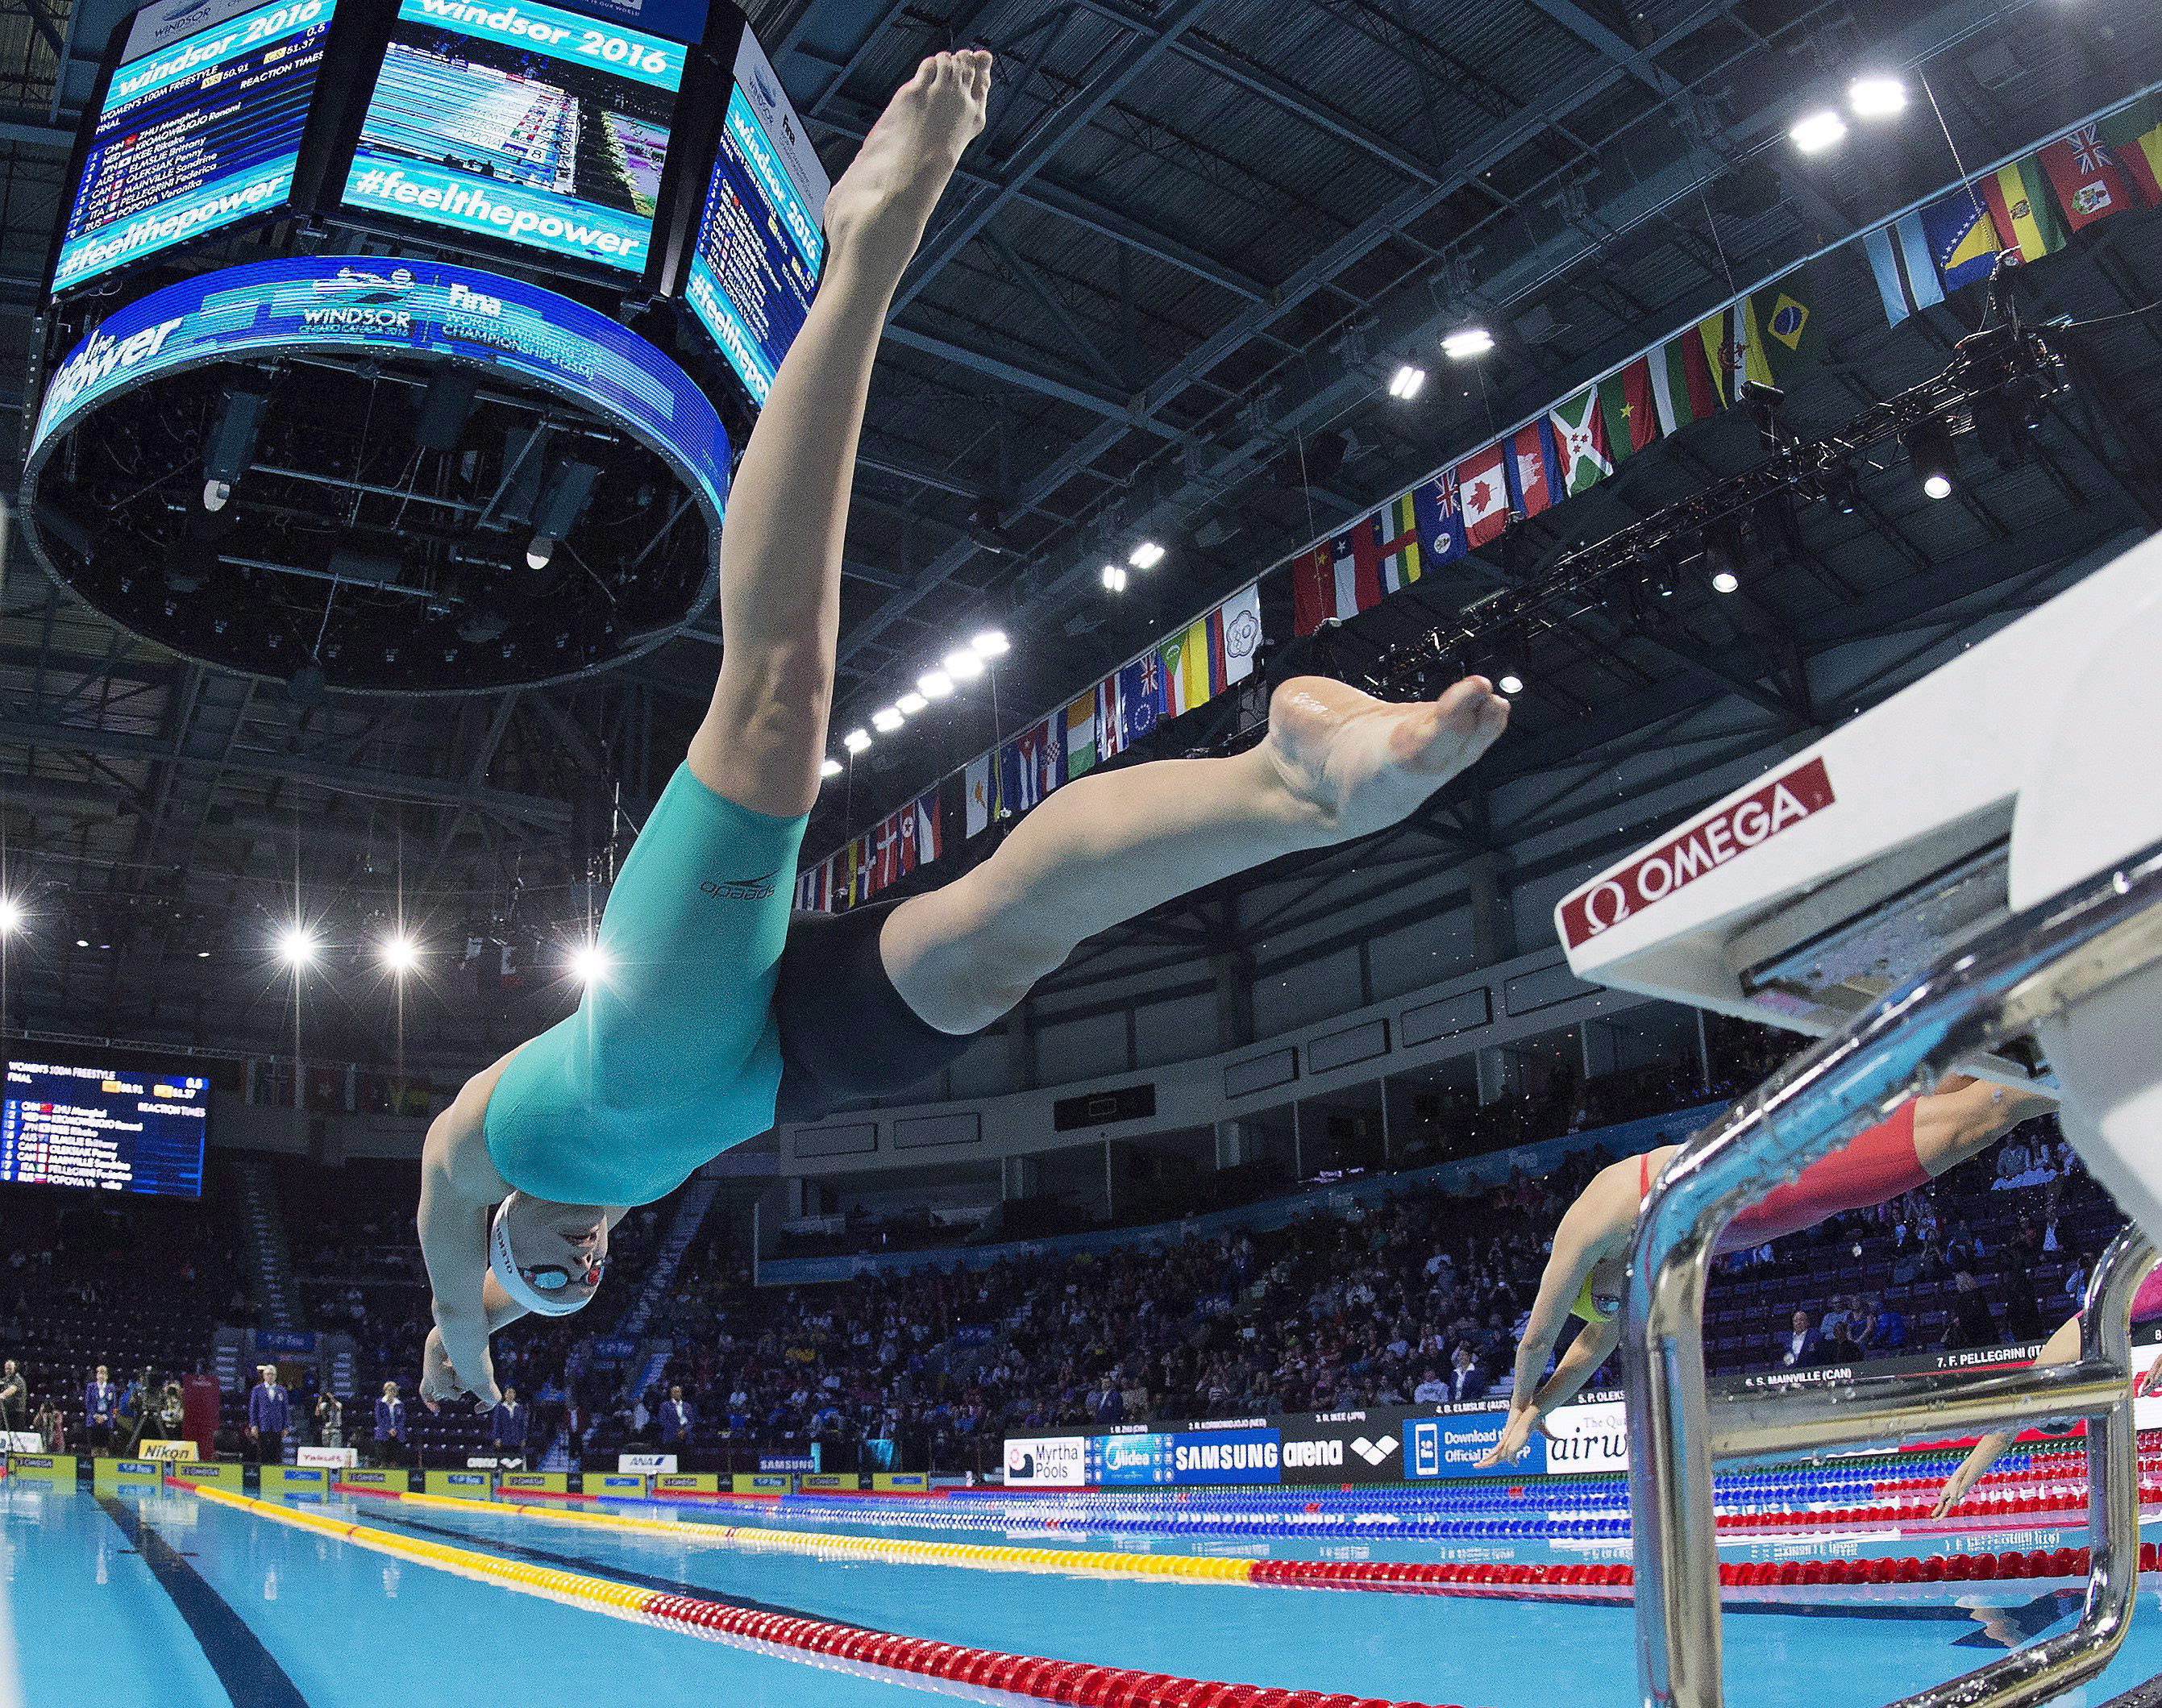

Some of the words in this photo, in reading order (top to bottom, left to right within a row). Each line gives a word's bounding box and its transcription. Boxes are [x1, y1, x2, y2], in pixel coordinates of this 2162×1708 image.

[155, 7, 211, 38] WINDSOR
[422, 0, 572, 45] windsor
[576, 31, 668, 74] 2016
[119, 34, 239, 97] windsor
[243, 1, 322, 45] 2016
[170, 65, 218, 93] FREESTYLE
[240, 64, 293, 89] REACTION
[294, 51, 325, 69] TIMES
[95, 118, 120, 135] FINAL
[104, 140, 125, 156] CHN
[530, 149, 543, 160] 8
[95, 173, 114, 188] AUS
[169, 137, 206, 157] Brittany
[102, 152, 121, 166] NED
[91, 185, 112, 199] CAN
[174, 148, 204, 164] Penny
[101, 164, 118, 177] JPN
[89, 197, 109, 210] CAN
[175, 152, 218, 174] Sandrine
[734, 109, 787, 202] windsor
[787, 201, 816, 261] 2016
[89, 208, 105, 220] ITA
[356, 169, 642, 259] #feelthepower
[61, 175, 285, 281] #feelthepower
[84, 218, 102, 232] RUS
[303, 307, 411, 328] WINDSOR
[692, 274, 771, 401] #feelthepo
[1637, 782, 1810, 903] OMEGA
[1937, 1357, 1947, 1368] 7.
[1948, 1354, 1959, 1367] F.
[1960, 1348, 2026, 1365] PELLEGRINI
[1756, 1376, 1766, 1386] S.
[1768, 1370, 1821, 1386] MAINVILLE
[1822, 1367, 1852, 1383] (CAN)
[1587, 1393, 1595, 1403] P.
[1583, 1416, 1603, 1429] The
[1445, 1428, 1497, 1445] Download
[144, 1444, 189, 1461] Nikon
[1036, 1444, 1079, 1464] Myrtha
[1176, 1442, 1279, 1471] SAMSUNG
[1283, 1439, 1344, 1469] arena
[1445, 1448, 1481, 1463] Official
[759, 1459, 815, 1471] SAMSUNG
[1035, 1461, 1069, 1480] Pools
